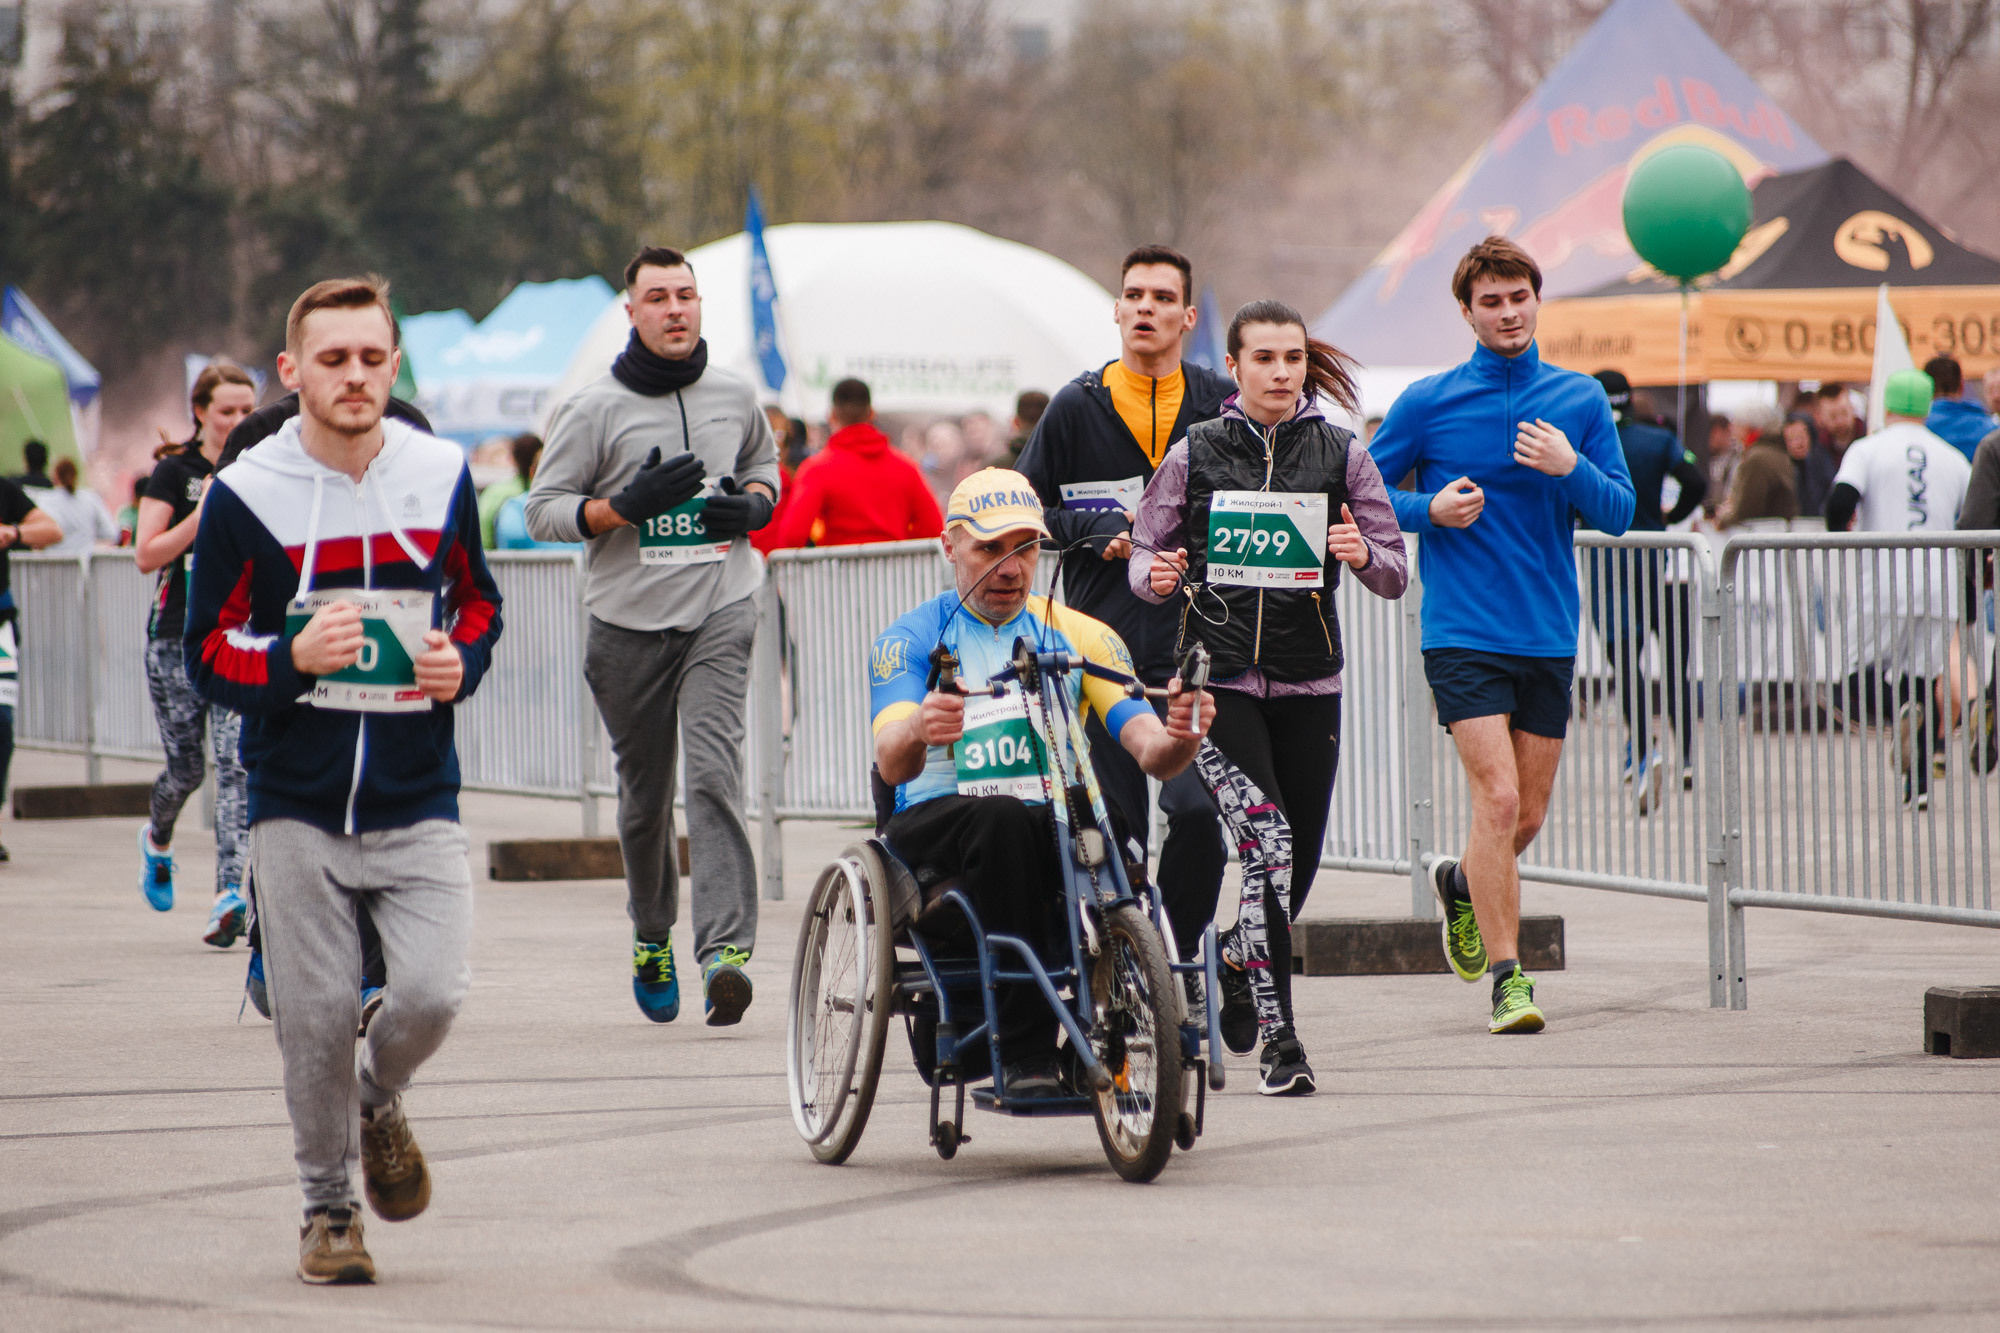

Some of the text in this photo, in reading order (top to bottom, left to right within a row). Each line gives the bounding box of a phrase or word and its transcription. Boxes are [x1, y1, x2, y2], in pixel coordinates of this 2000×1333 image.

[1547, 75, 1796, 157] Red Bull
[1230, 498, 1282, 509] Жилстрой-1
[646, 512, 706, 537] 1883
[1213, 526, 1291, 556] 2799
[646, 550, 673, 559] 10 KM
[1213, 567, 1244, 579] 10 KM
[969, 703, 1025, 722] Жилстрой-1
[964, 735, 1032, 770] 3104
[966, 783, 999, 797] 10 KM
